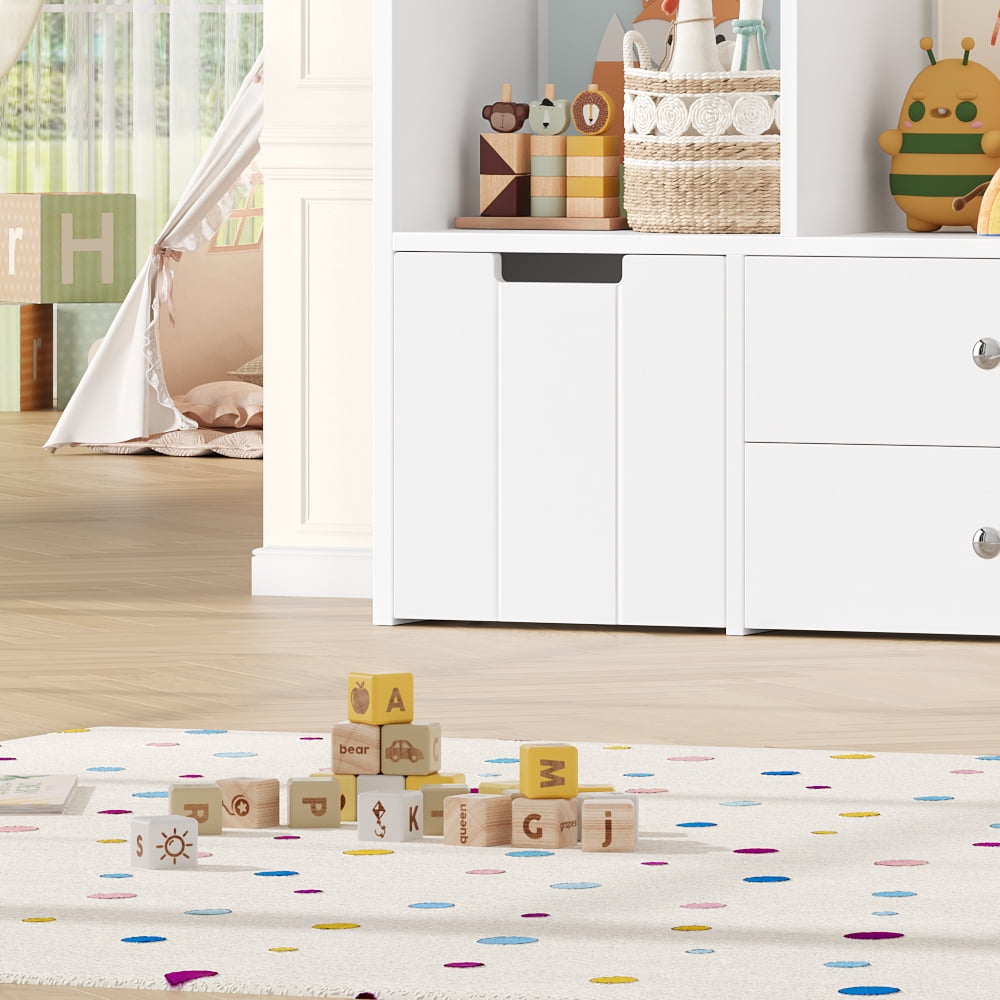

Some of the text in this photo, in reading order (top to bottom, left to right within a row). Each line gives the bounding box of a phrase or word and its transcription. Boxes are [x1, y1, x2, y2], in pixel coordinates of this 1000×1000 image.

[60, 212, 115, 285] H
[386, 687, 406, 713] A
[339, 744, 370, 755] bear
[301, 797, 327, 817] P
[409, 805, 420, 832] K
[459, 803, 467, 844] queen
[522, 813, 543, 840] G
[136, 834, 144, 858] S
